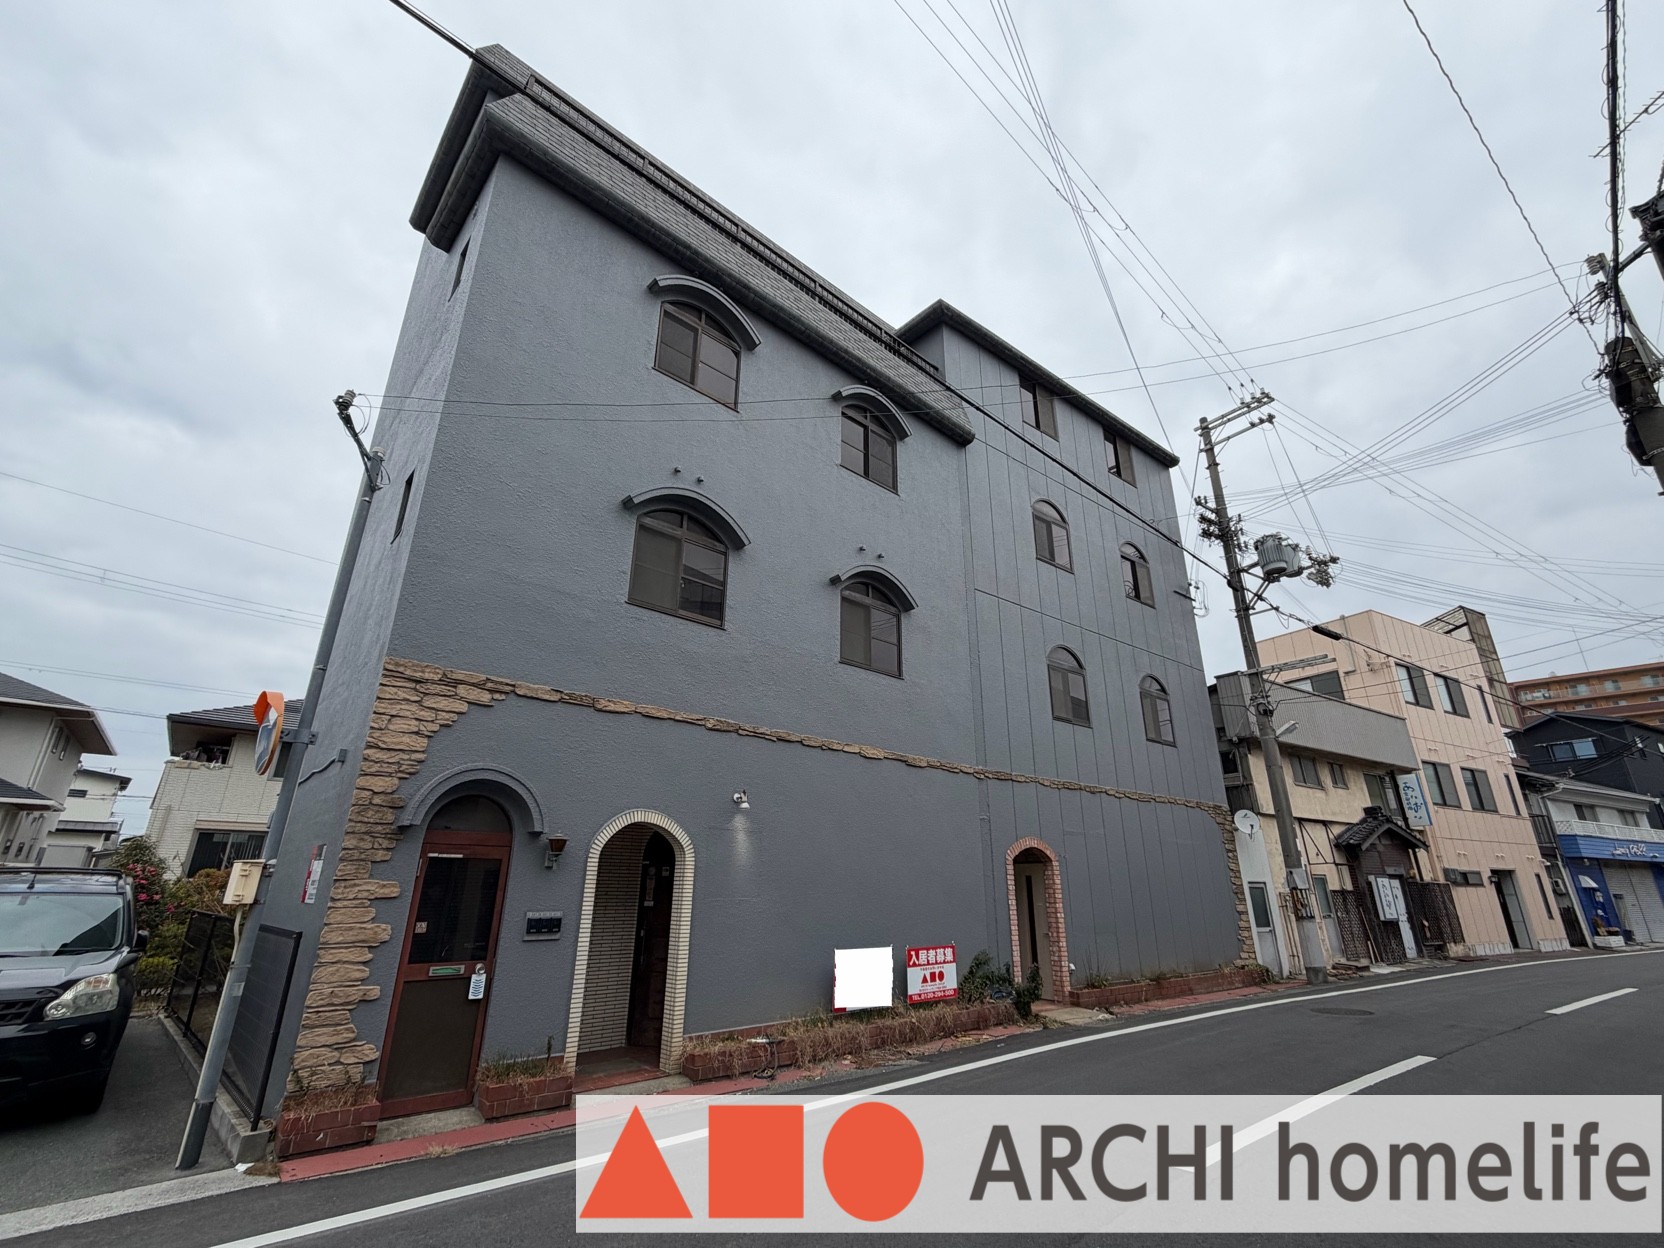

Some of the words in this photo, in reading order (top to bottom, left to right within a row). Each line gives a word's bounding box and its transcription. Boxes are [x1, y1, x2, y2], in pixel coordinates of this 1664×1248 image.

[909, 948, 954, 966] 入居者募集
